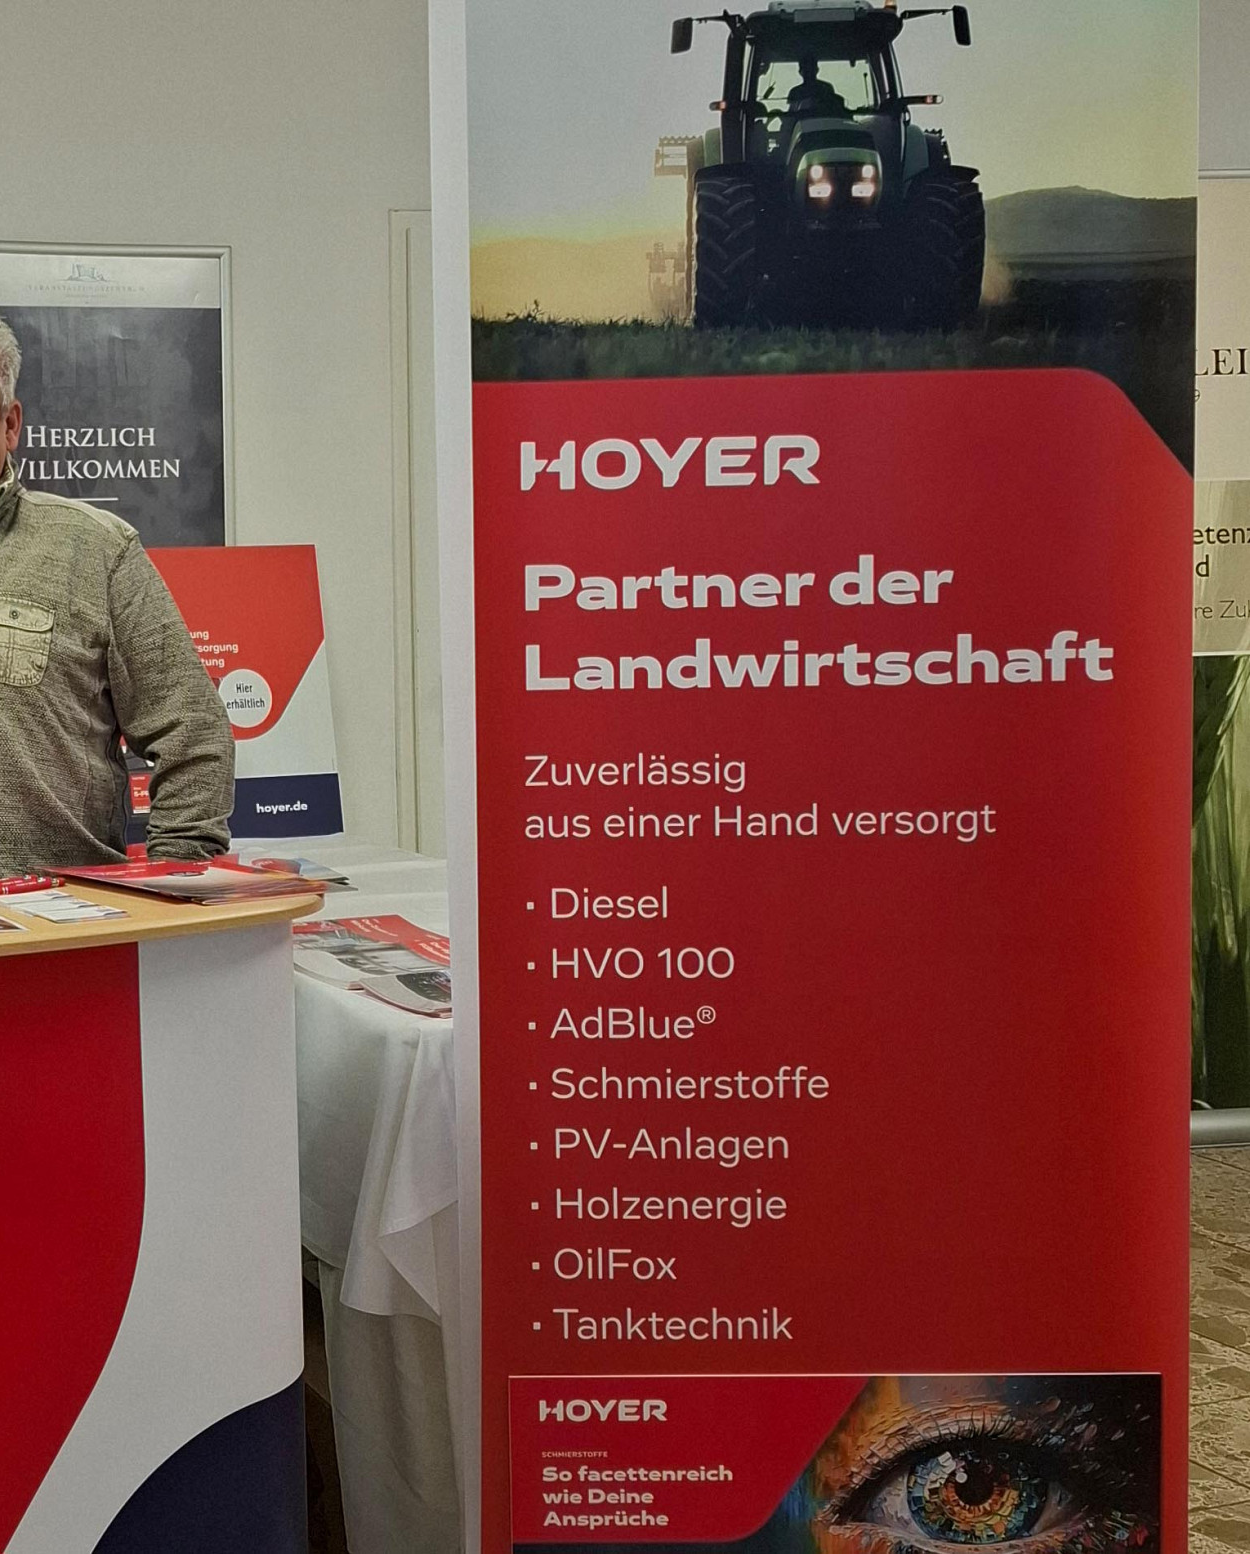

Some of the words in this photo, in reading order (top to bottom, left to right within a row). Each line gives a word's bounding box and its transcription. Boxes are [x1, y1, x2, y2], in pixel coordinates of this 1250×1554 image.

[1194, 347, 1249, 376] EI
[26, 424, 156, 448] HERZLICH
[520, 434, 821, 492] HOYER
[524, 564, 816, 612] Partner
[828, 554, 954, 605] der
[525, 630, 1115, 691] Landwirtschaft
[226, 698, 265, 710] erhältlich
[236, 683, 253, 694] Hier
[524, 753, 747, 793] Zuverlässig
[256, 801, 308, 814] hoyer.de
[524, 812, 591, 839] aus
[603, 807, 701, 838] einer
[714, 802, 818, 837] Hand
[832, 805, 998, 843] versorgt
[550, 886, 669, 919] Diesel
[551, 947, 644, 979] HVO
[657, 947, 736, 979] 100
[550, 1005, 717, 1039] AdBlue®
[550, 1066, 830, 1100] Schmierstoffe
[554, 1127, 789, 1168] PV-Anlagen
[555, 1187, 788, 1228] Holzenergie
[553, 1247, 677, 1281] OilFox
[553, 1307, 793, 1340] Tanktechnik
[539, 1399, 668, 1423] HOYER
[542, 1450, 608, 1459] SCHMIERSTOFFE
[542, 1467, 572, 1482] So
[577, 1465, 733, 1482] facettenreich
[542, 1489, 582, 1504] wie
[588, 1488, 654, 1504] Deine
[543, 1510, 669, 1530] Ansprüche
